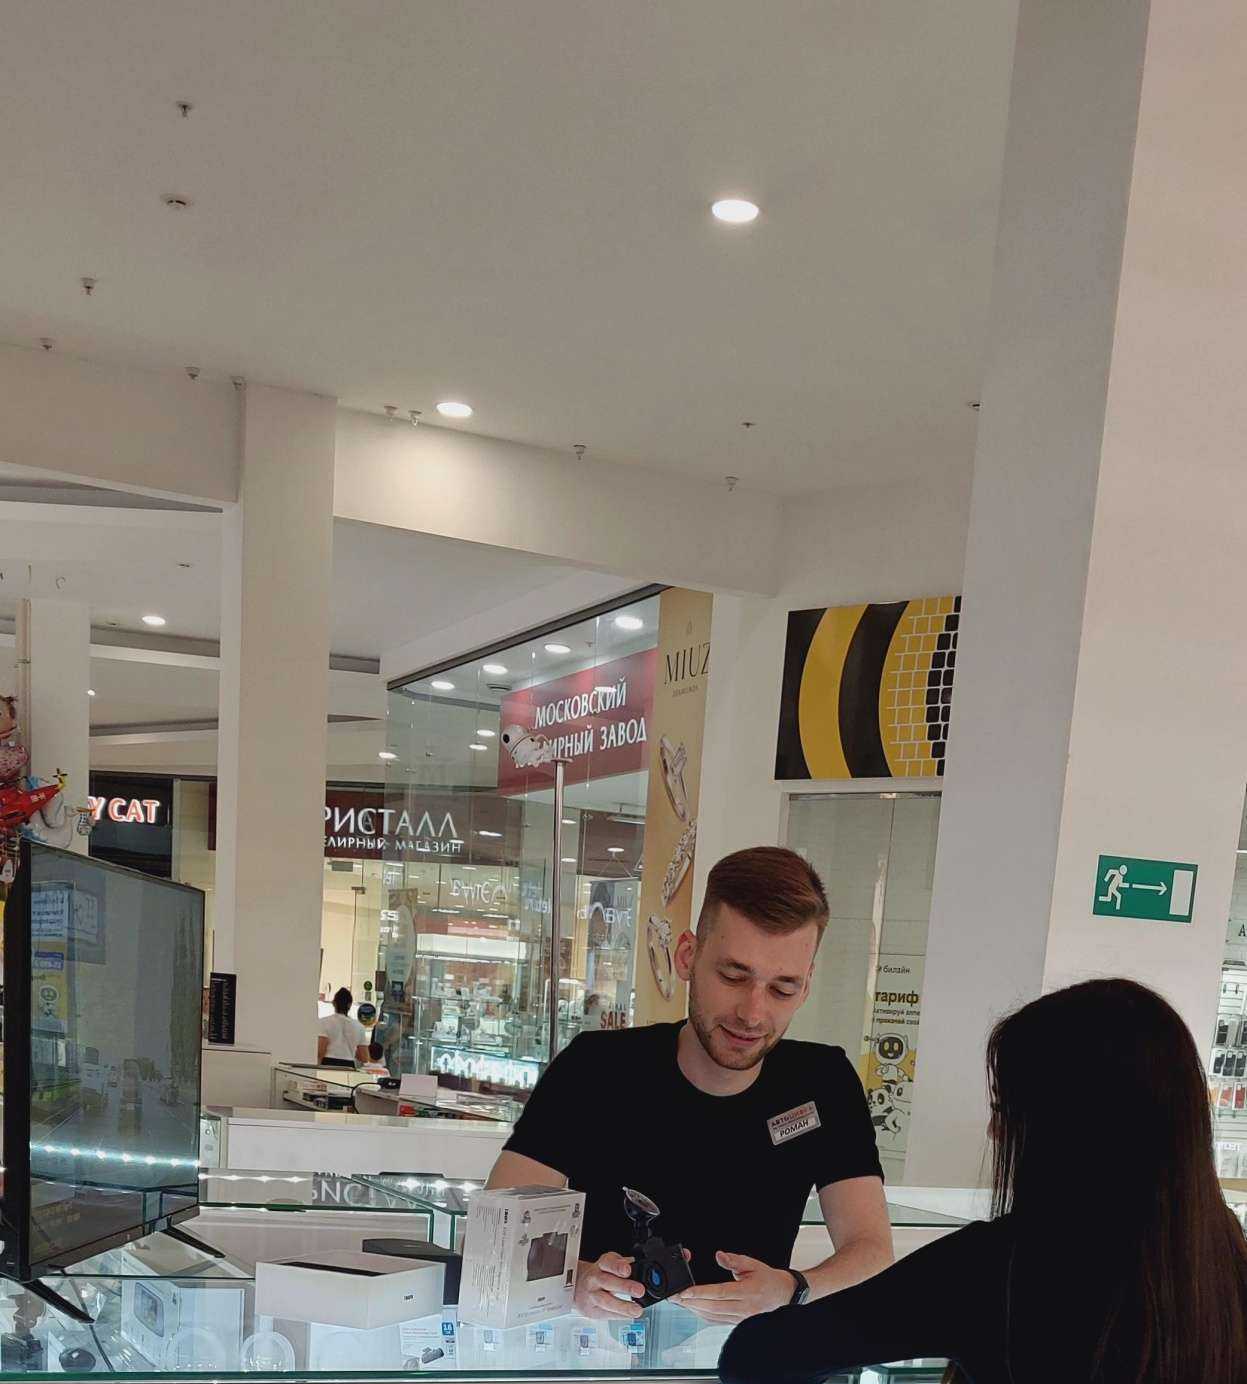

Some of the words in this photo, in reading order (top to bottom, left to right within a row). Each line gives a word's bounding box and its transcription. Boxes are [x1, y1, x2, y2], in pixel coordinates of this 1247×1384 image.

[534, 678, 627, 729] МОСКОВСКИЙ
[600, 718, 647, 750] ЗАВОД
[108, 797, 160, 824] CAT
[875, 990, 919, 1007] тариф
[600, 1011, 627, 1029] SALE
[779, 1119, 809, 1137] РОМАН
